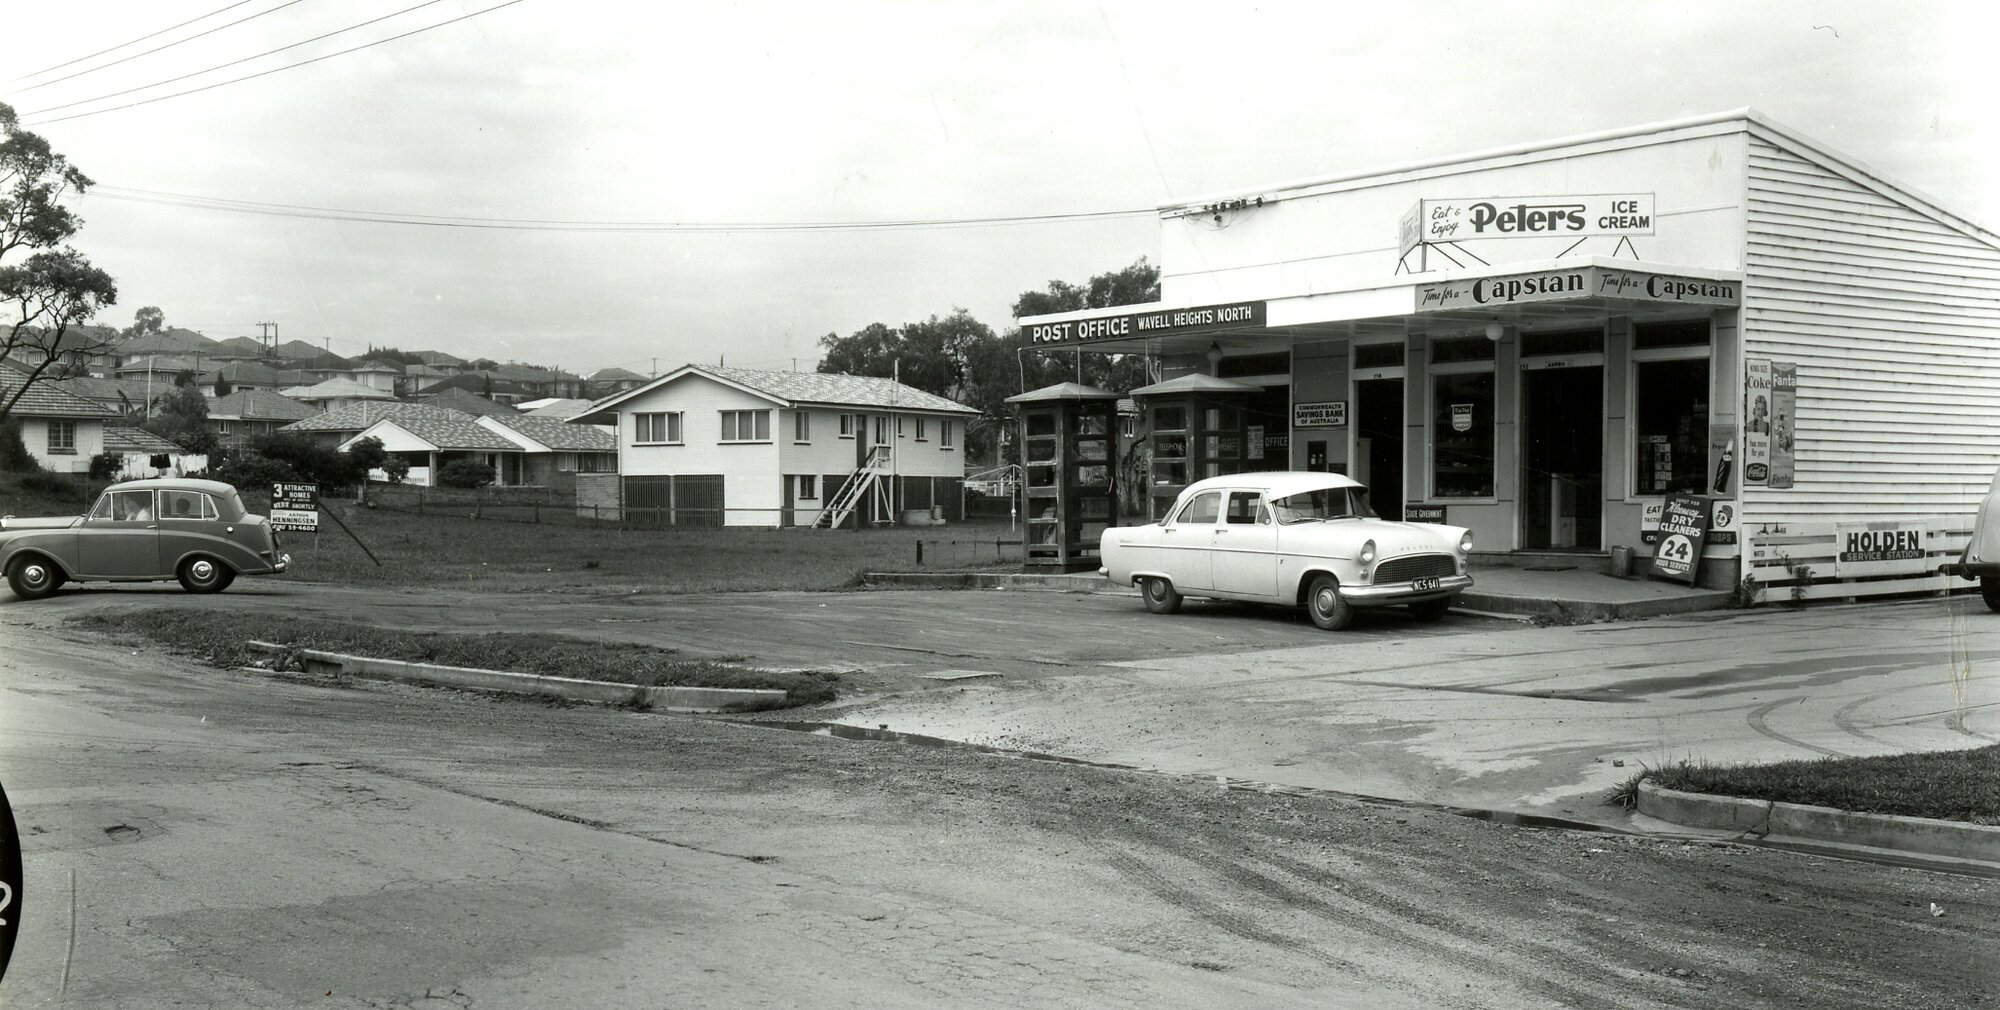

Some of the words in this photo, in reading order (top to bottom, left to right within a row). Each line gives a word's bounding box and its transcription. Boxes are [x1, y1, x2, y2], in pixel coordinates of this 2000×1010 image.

[1432, 206, 1452, 220] Eat
[1611, 201, 1638, 214] ICE
[1469, 202, 1586, 233] Peters
[1598, 215, 1650, 230] CREAM
[1431, 219, 1460, 236] Enjoy
[1423, 288, 1441, 305] Time
[1440, 285, 1453, 306] for
[1472, 272, 1584, 305] Capstan
[1601, 273, 1619, 291] Time
[1618, 273, 1632, 292] for
[1645, 274, 1734, 299] Capstan
[1033, 324, 1071, 343] POST
[1078, 317, 1129, 339] OFFICE
[1137, 313, 1170, 331] WAVELL
[1173, 310, 1213, 327] HEIGHTS
[1217, 306, 1252, 324] NORTH
[1748, 376, 1771, 389] Coke
[1773, 373, 1796, 387] Fanta
[1159, 443, 1184, 452] TELEPHONE
[1265, 436, 1288, 447] OFFICE
[273, 483, 282, 498] 3
[283, 484, 316, 492] ATTRACTIVE
[1407, 509, 1418, 518] STATE
[1419, 509, 1442, 518] GOVERNMENT
[1646, 505, 1662, 514] EAT
[1671, 514, 1695, 526] DRY
[1660, 522, 1701, 537] CLEANERS
[1847, 531, 1919, 552] HOLDEN
[1664, 540, 1688, 560] 24
[1847, 552, 1881, 561] SERVICE
[1655, 558, 1669, 567] HOUR
[1669, 561, 1691, 571] SERVICE
